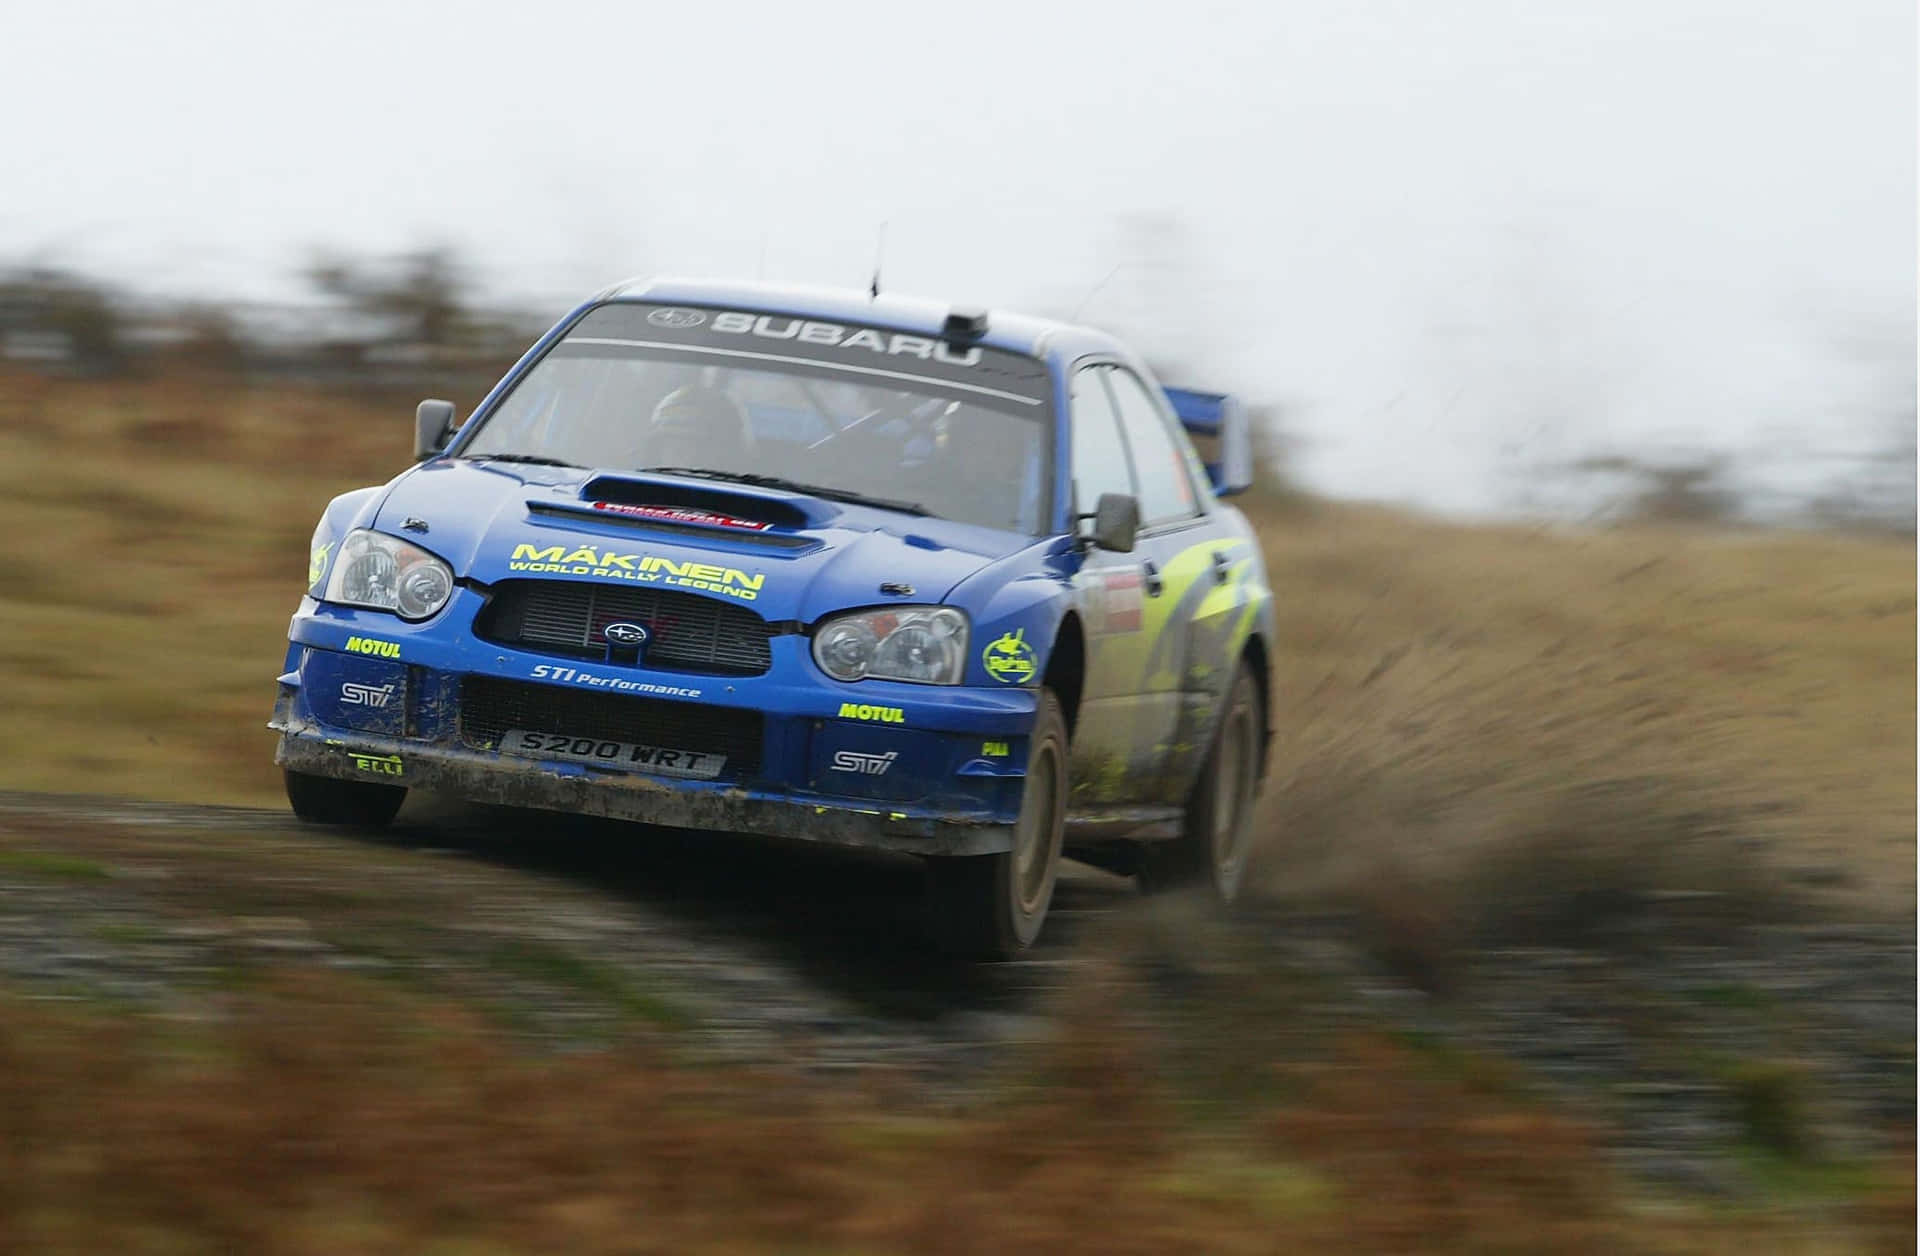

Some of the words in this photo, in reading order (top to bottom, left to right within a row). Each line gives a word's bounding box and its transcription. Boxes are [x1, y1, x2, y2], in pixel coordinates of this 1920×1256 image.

[710, 311, 983, 368] SUBARU
[509, 561, 590, 576] WORLD
[592, 567, 661, 582] RALLY
[664, 577, 758, 601] LEGEND
[511, 543, 765, 591] MÄKINEN
[345, 636, 401, 658] MOTUL
[530, 664, 576, 682] STI
[577, 673, 702, 698] Performance
[838, 703, 905, 723] MOTUL
[520, 733, 621, 759] S200
[630, 746, 706, 770] WRT
